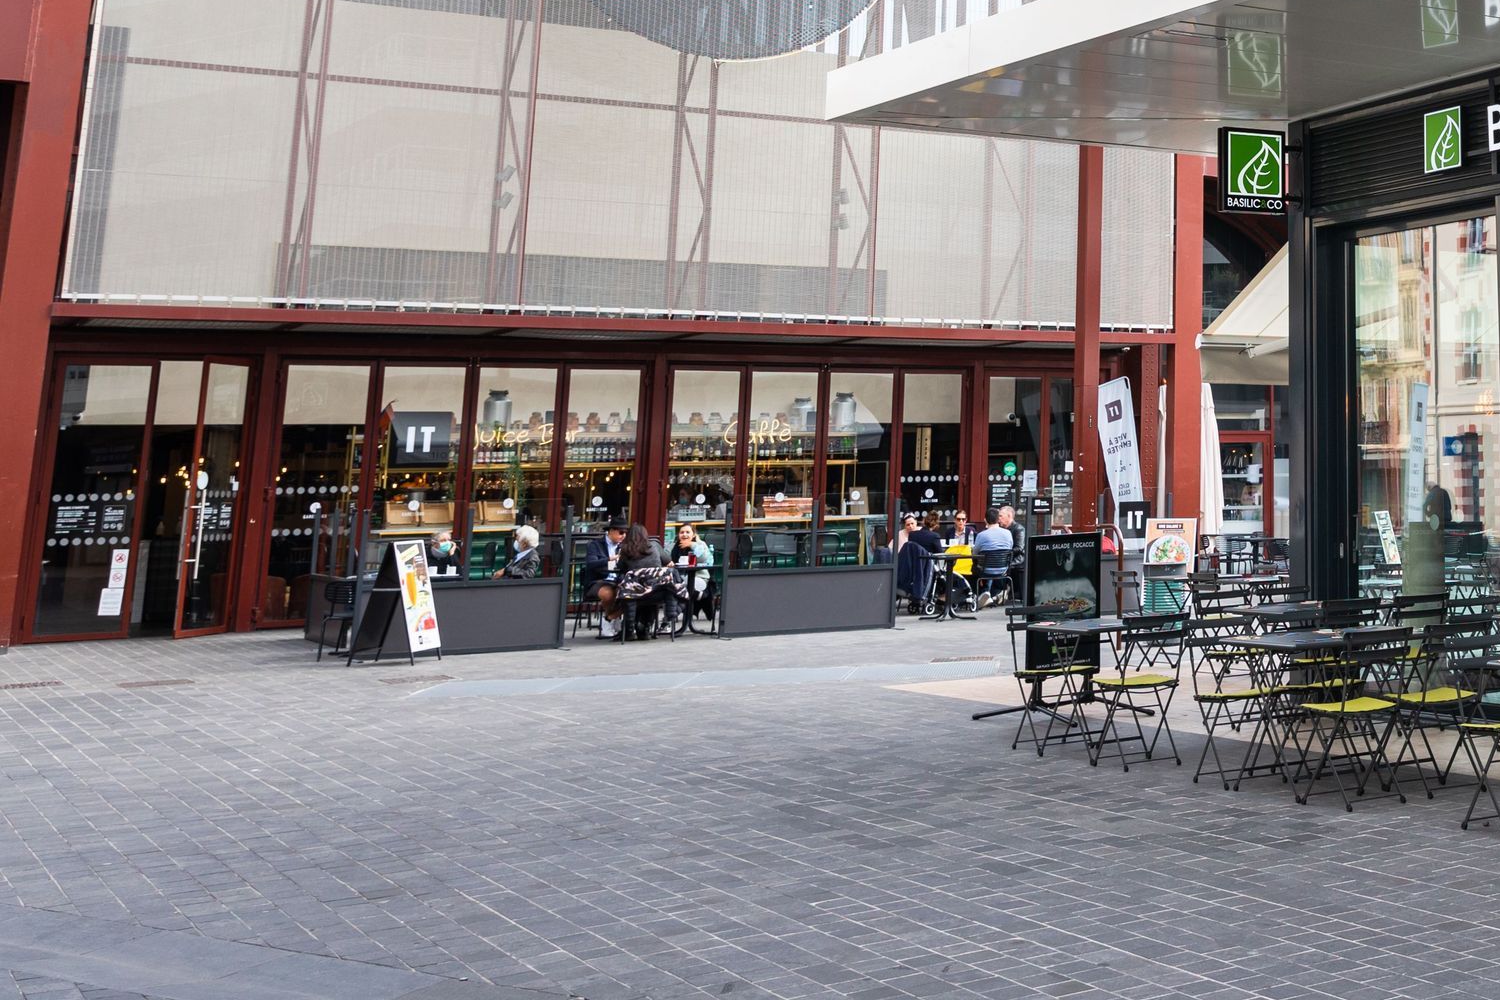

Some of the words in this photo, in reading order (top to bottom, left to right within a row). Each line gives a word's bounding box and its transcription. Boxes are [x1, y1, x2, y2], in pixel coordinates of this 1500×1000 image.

[1227, 197, 1283, 210] BASILIC&CO
[405, 426, 436, 453] IT
[473, 423, 530, 450] Juice
[1127, 510, 1144, 530] IT
